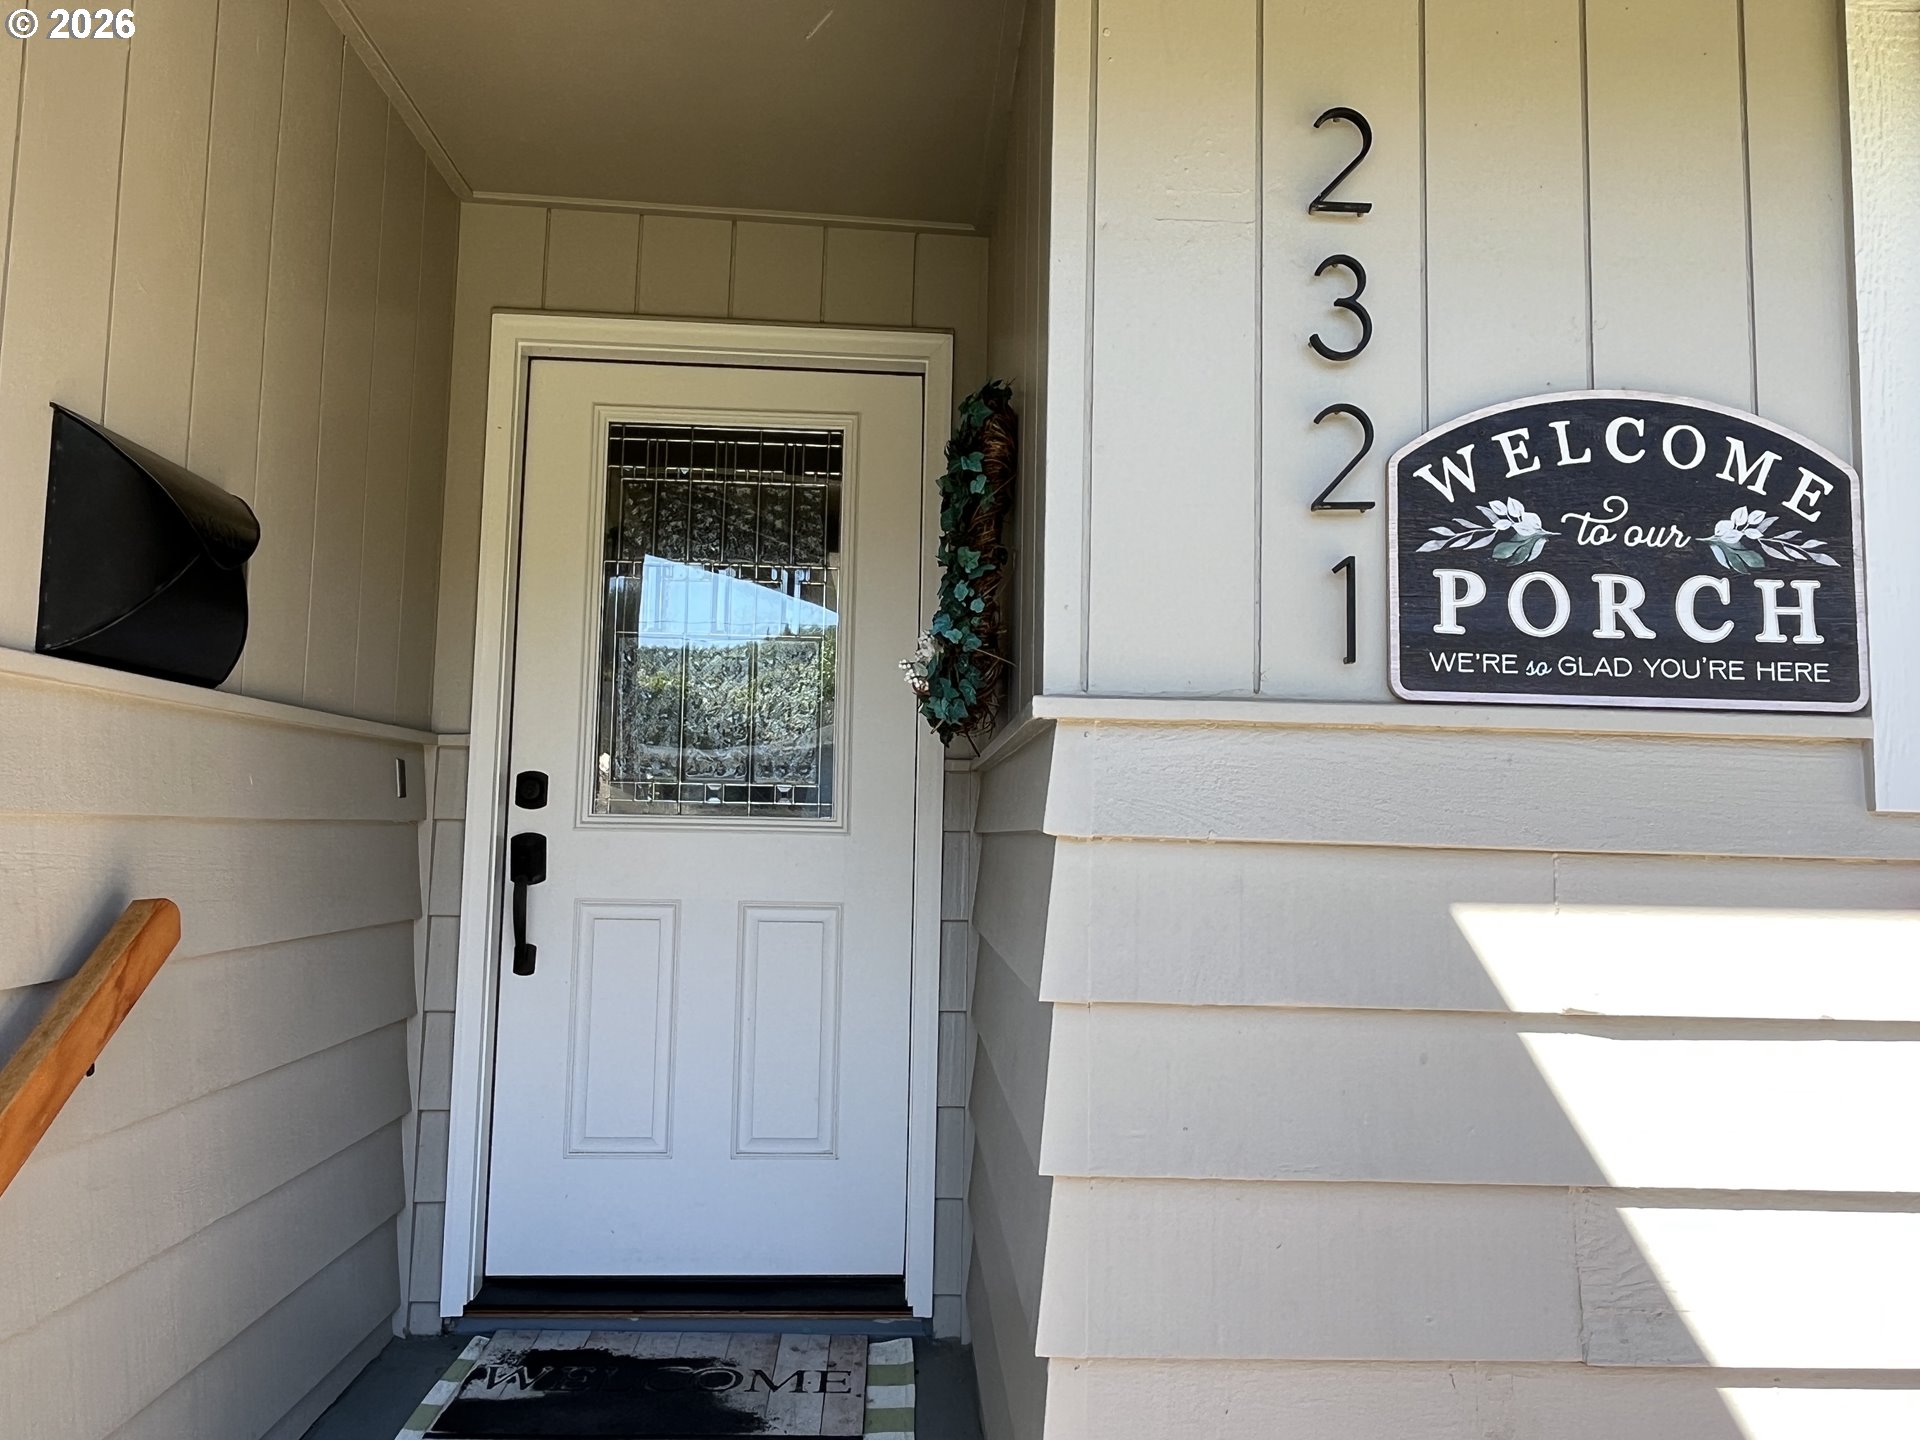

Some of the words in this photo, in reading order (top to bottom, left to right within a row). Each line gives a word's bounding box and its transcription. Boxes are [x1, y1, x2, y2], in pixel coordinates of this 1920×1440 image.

[1412, 416, 1834, 523] WELCOME
[1560, 495, 1629, 546] to
[1624, 524, 1692, 549] our
[1432, 568, 1826, 645] PORCH
[1429, 652, 1519, 675] WE'RE
[1525, 659, 1552, 676] so
[1557, 656, 1633, 678] GLAD
[1643, 657, 1746, 681] YOU'RE
[1756, 661, 1831, 683] HERE
